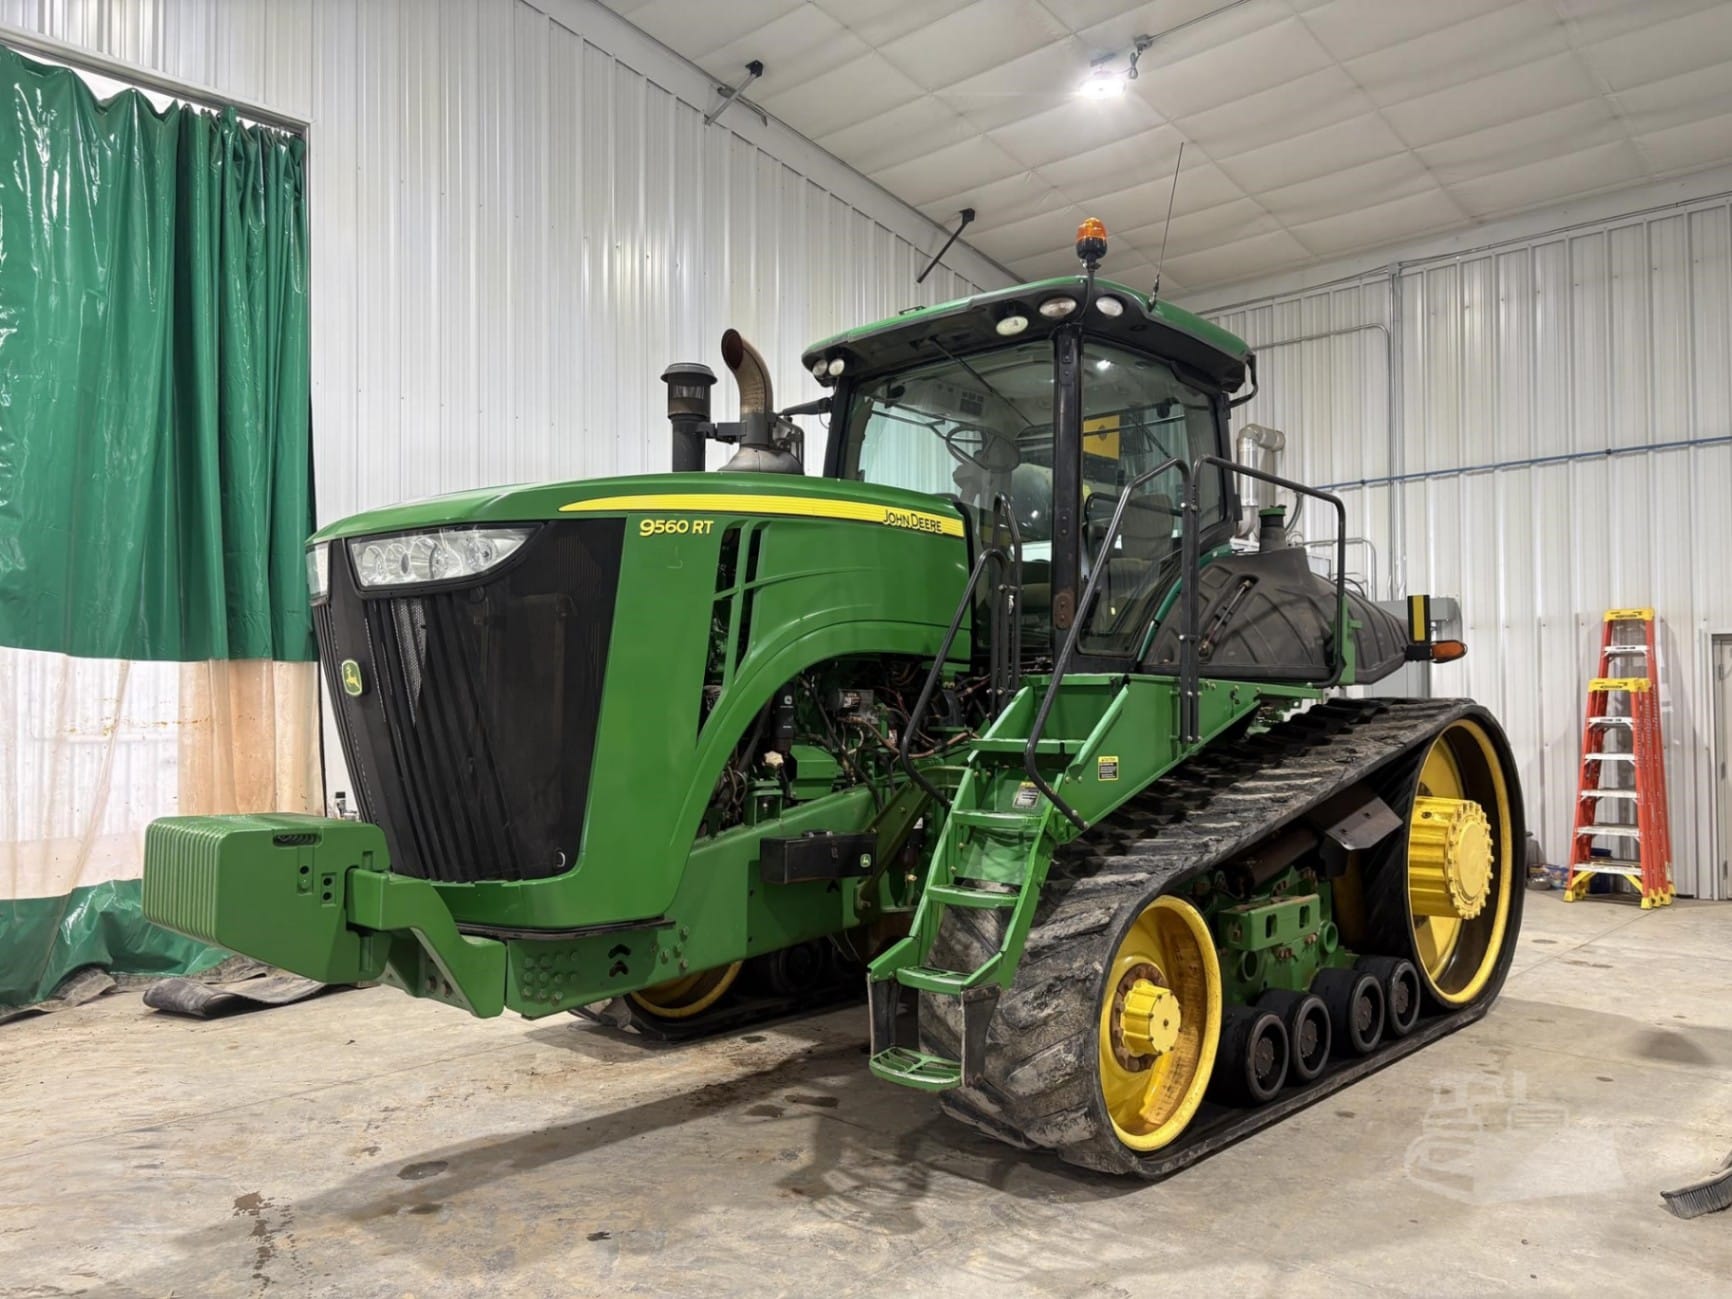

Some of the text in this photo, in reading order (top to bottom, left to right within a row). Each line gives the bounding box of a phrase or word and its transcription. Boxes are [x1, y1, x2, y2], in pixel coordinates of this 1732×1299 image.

[639, 518, 715, 537] 9560 RT
[883, 509, 943, 533] JOHN DEERE
